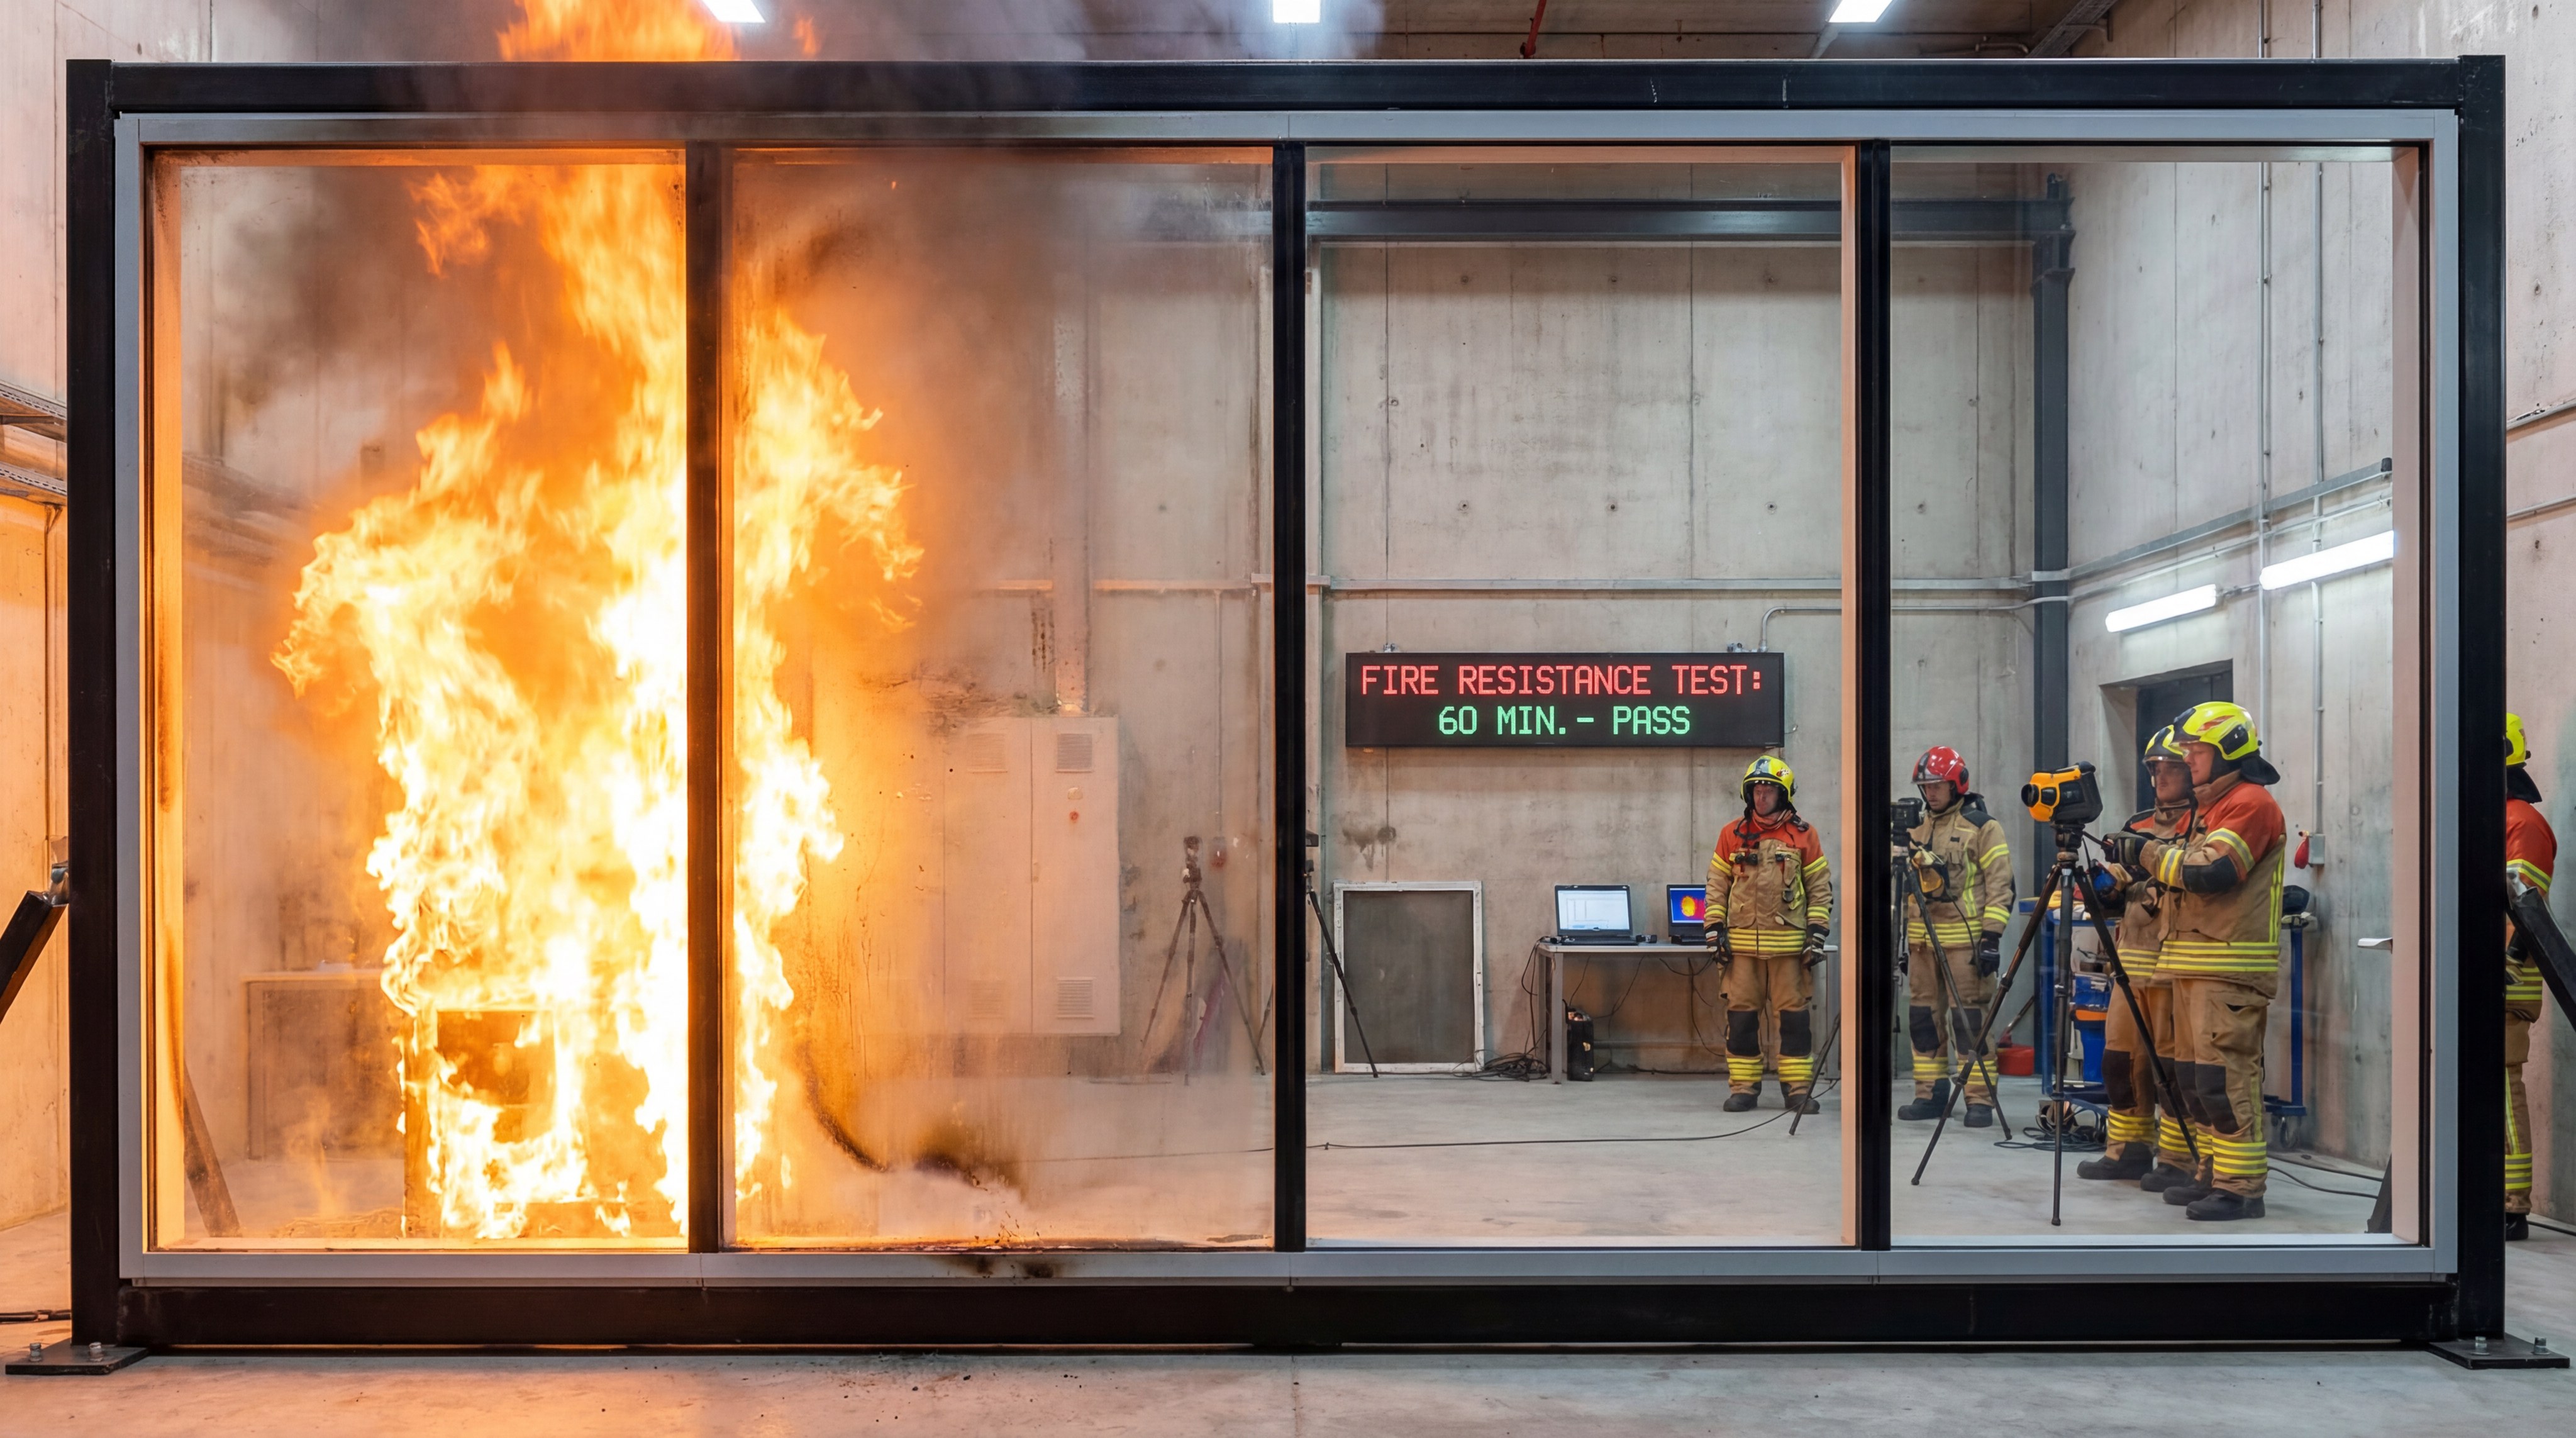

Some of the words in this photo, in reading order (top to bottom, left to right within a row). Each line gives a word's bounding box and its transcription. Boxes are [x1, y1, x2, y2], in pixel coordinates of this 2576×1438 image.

[1362, 665, 1439, 695] FIRE
[1458, 665, 1652, 695] RESISTANCE
[1672, 664, 1761, 695] TEST:
[1438, 705, 1477, 735] 60
[1613, 705, 1690, 735] PASS
